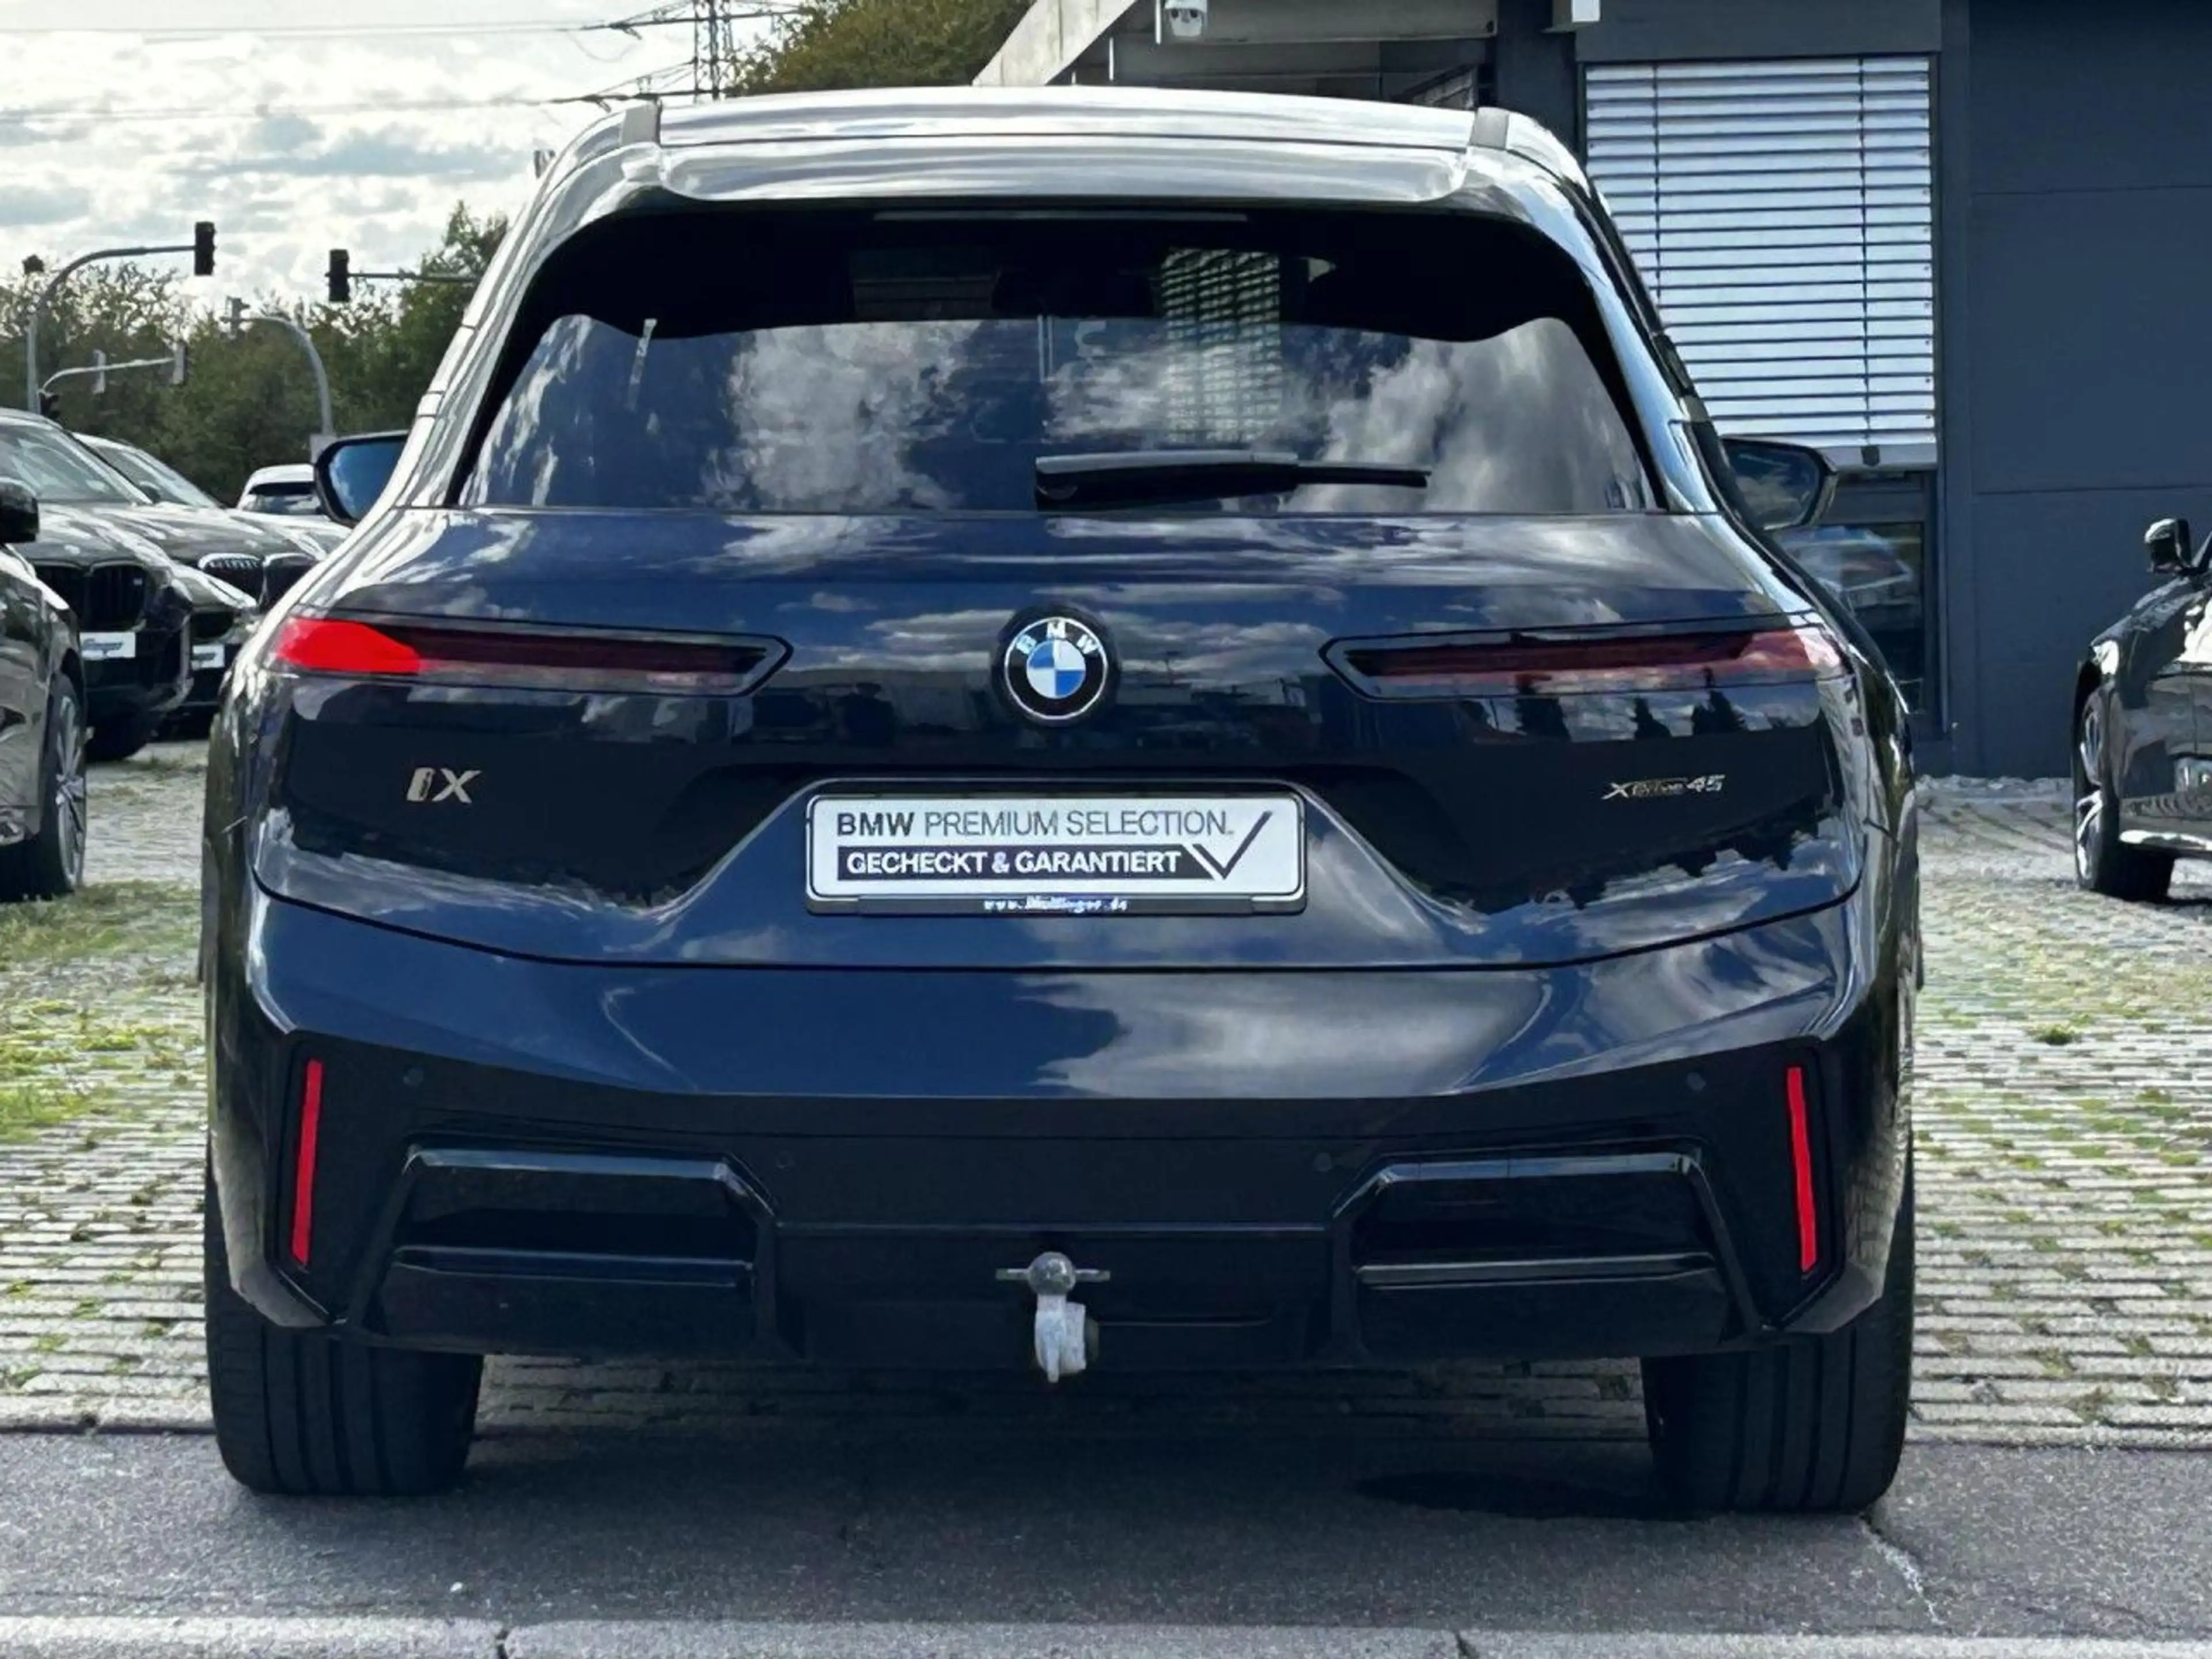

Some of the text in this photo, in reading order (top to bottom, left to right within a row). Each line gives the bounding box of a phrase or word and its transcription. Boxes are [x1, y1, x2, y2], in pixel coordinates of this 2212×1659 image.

[1016, 621, 1099, 655] BMW
[838, 812, 914, 836] BMW
[925, 810, 1058, 836] PREMIUM
[846, 850, 1181, 874] GECHECKT & GARANTIERT
